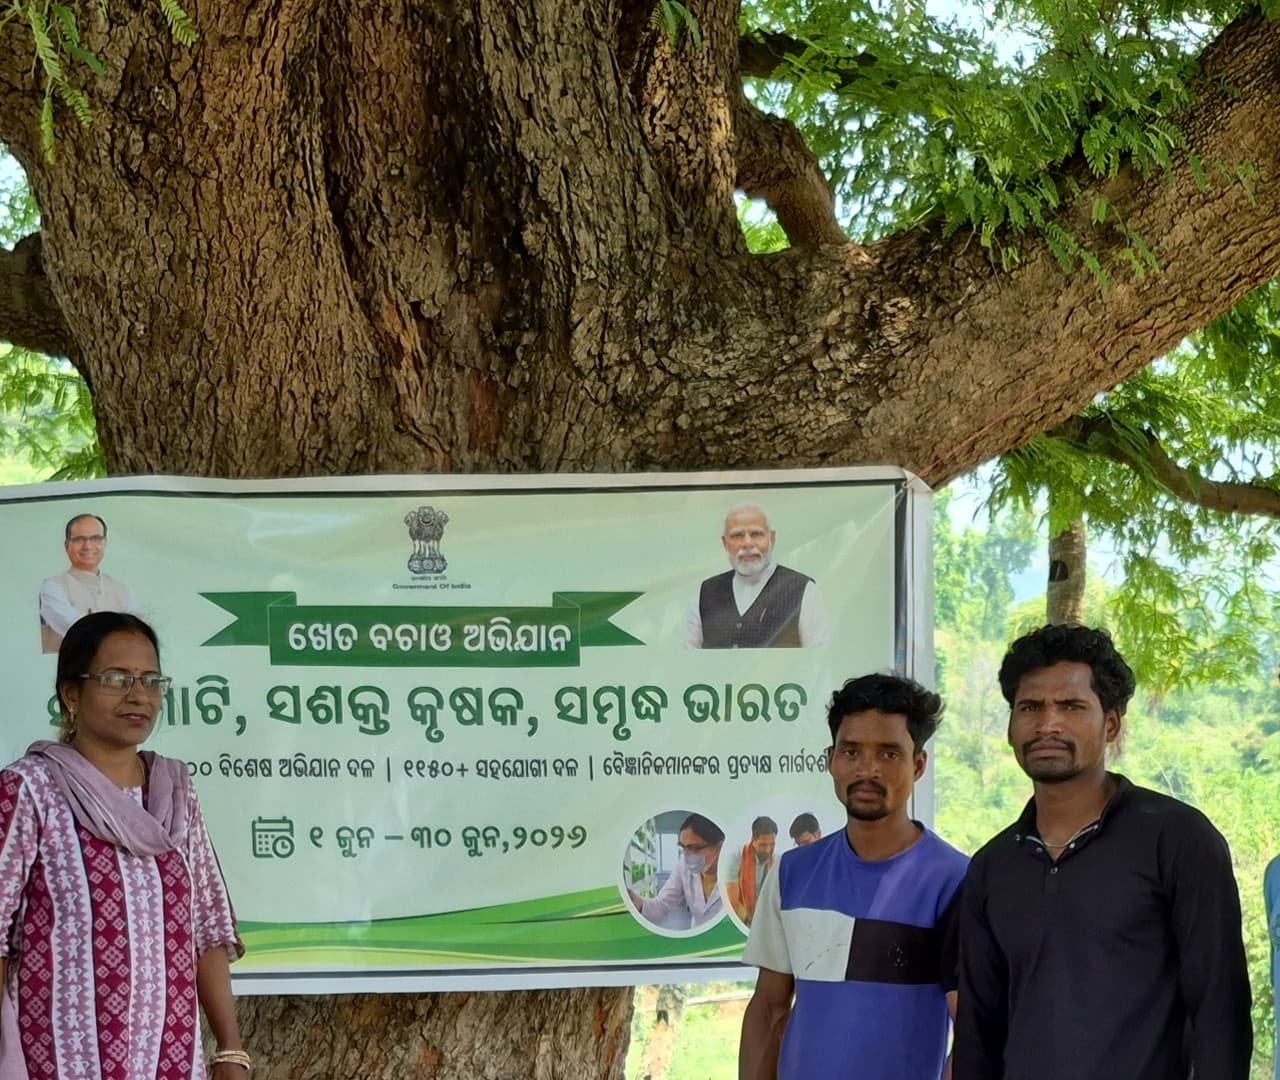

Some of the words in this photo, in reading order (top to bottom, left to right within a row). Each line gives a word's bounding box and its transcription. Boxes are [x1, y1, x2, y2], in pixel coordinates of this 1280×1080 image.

[288, 623, 358, 651] ଖେତ
[369, 623, 452, 652] ବଚାଓ
[463, 616, 572, 652] ଅଭିଯାନ
[266, 685, 391, 736] ସଶକ୍ତ
[406, 685, 539, 744] କୃଷକ,
[554, 685, 669, 742] ସମୃଦ୍ଧ
[682, 682, 808, 724] ଭାରତ
[188, 760, 213, 777] ୦୦
[219, 752, 273, 778] ବିଶେଷ
[278, 752, 341, 778] ଅଭିଯାନ
[346, 757, 375, 778] ଦଳ
[475, 758, 548, 781] ସହଯୋଗୀ
[552, 757, 579, 777] ଦଳ
[309, 825, 324, 849] ୧
[335, 825, 375, 858] ଜୁନ
